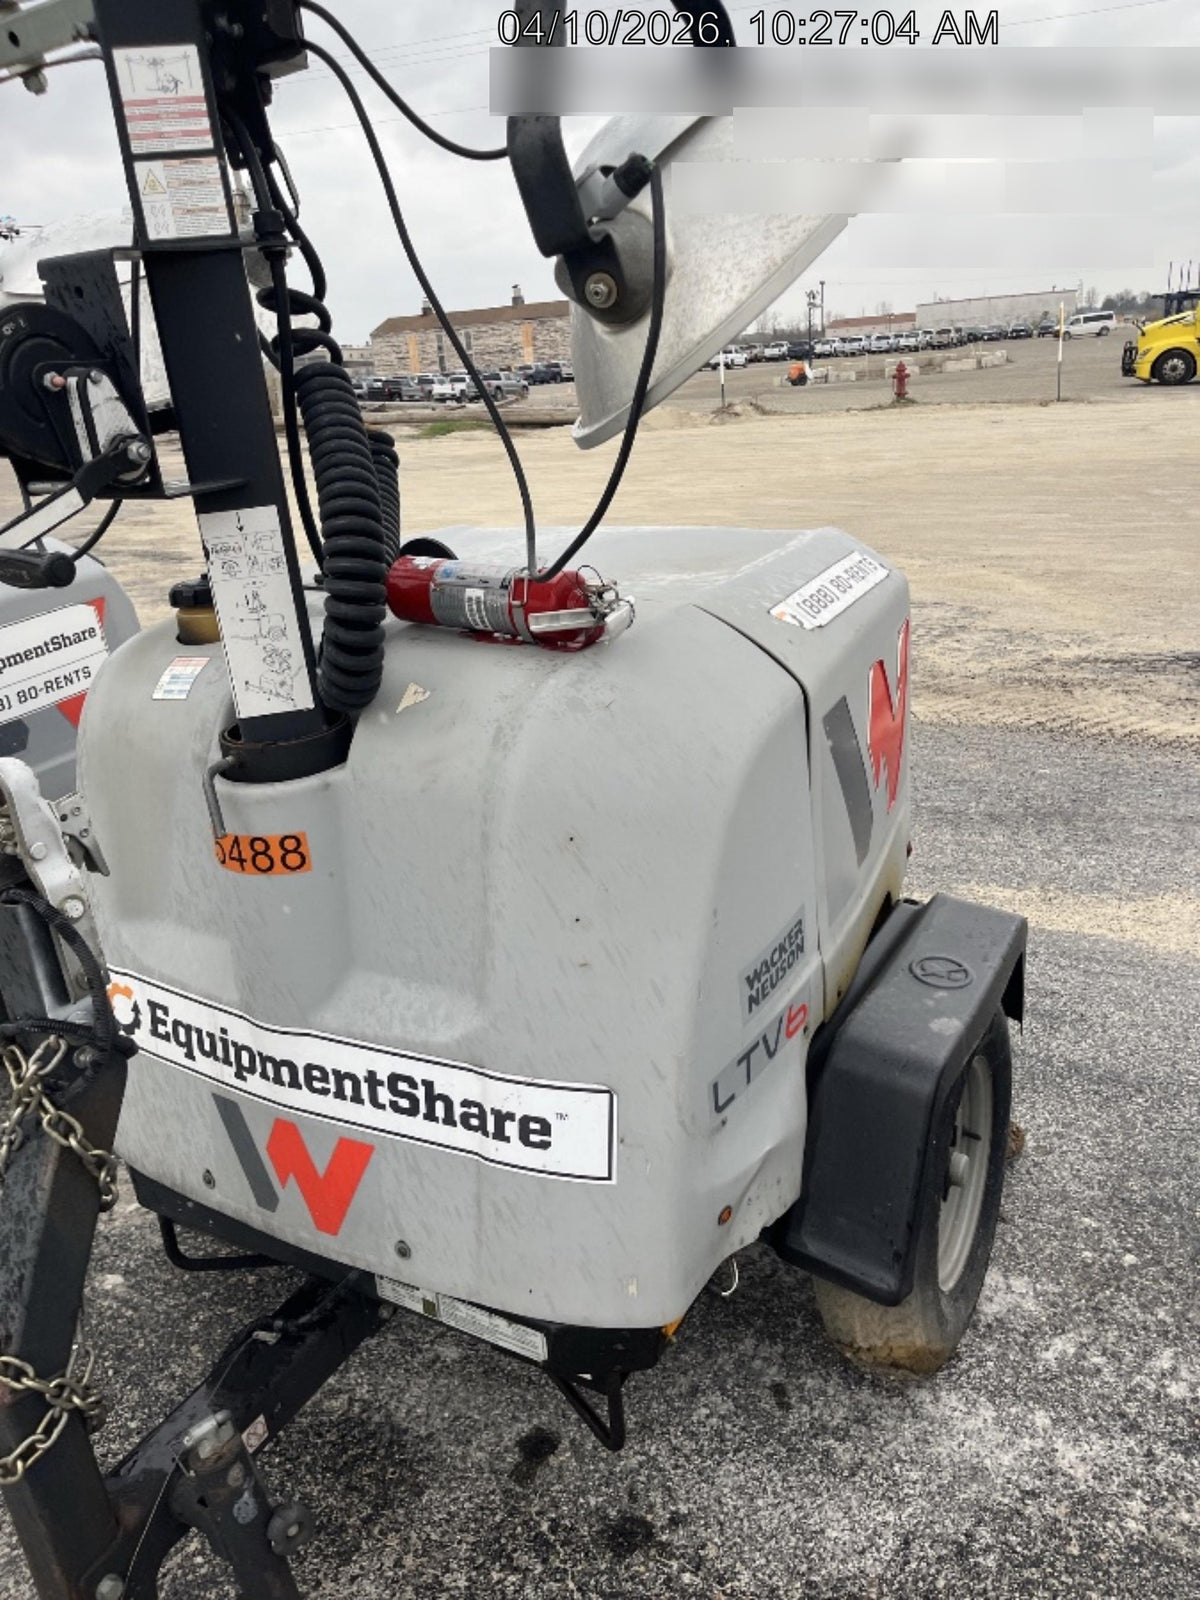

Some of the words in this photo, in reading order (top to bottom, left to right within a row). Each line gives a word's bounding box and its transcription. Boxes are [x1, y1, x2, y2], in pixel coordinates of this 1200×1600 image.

[796, 584, 840, 620] (888)
[16, 666, 91, 704] 80-RENTS
[745, 918, 804, 991] WACKER
[748, 935, 805, 1014] NEUSON
[147, 999, 553, 1150] EquipmentShare
[712, 1003, 808, 1114] LTV6
